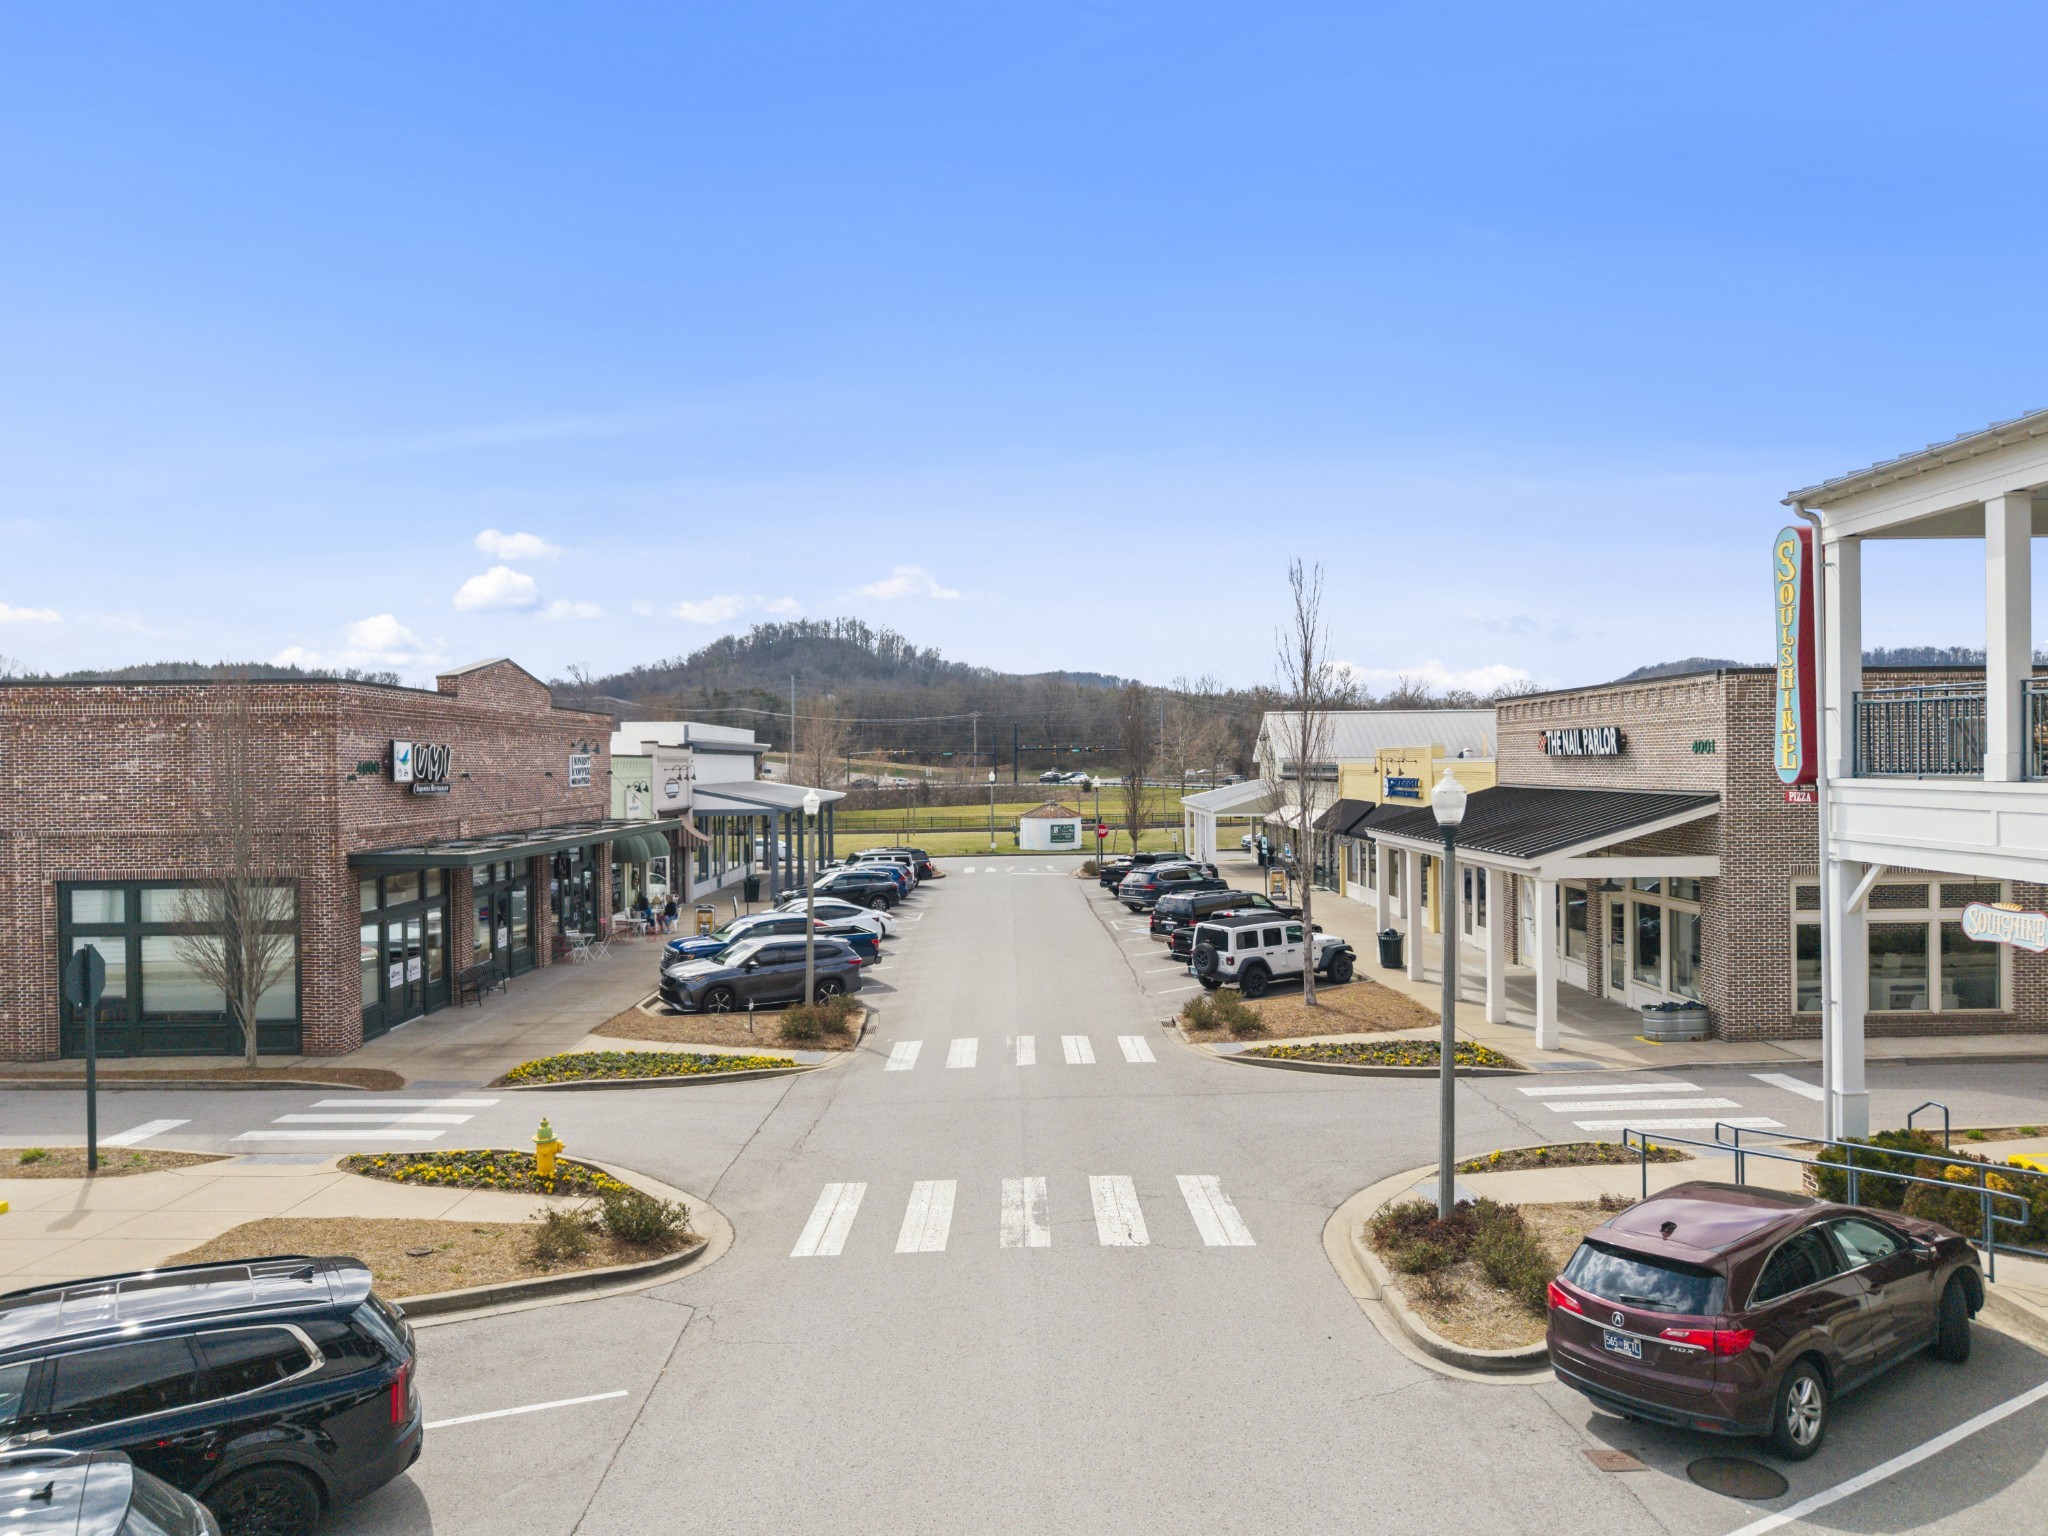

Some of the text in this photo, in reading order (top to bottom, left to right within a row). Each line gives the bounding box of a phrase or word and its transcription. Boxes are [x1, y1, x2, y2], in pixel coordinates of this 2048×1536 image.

[1777, 539, 1797, 770] SOULSHINE
[1545, 727, 1618, 755] THE NAIL PARLOR
[1692, 739, 1715, 754] 4001
[414, 744, 451, 781] UMI
[1788, 791, 1811, 803] PIZZA
[1968, 908, 2046, 948] SOULSHINE
[1606, 1335, 1618, 1346] 565
